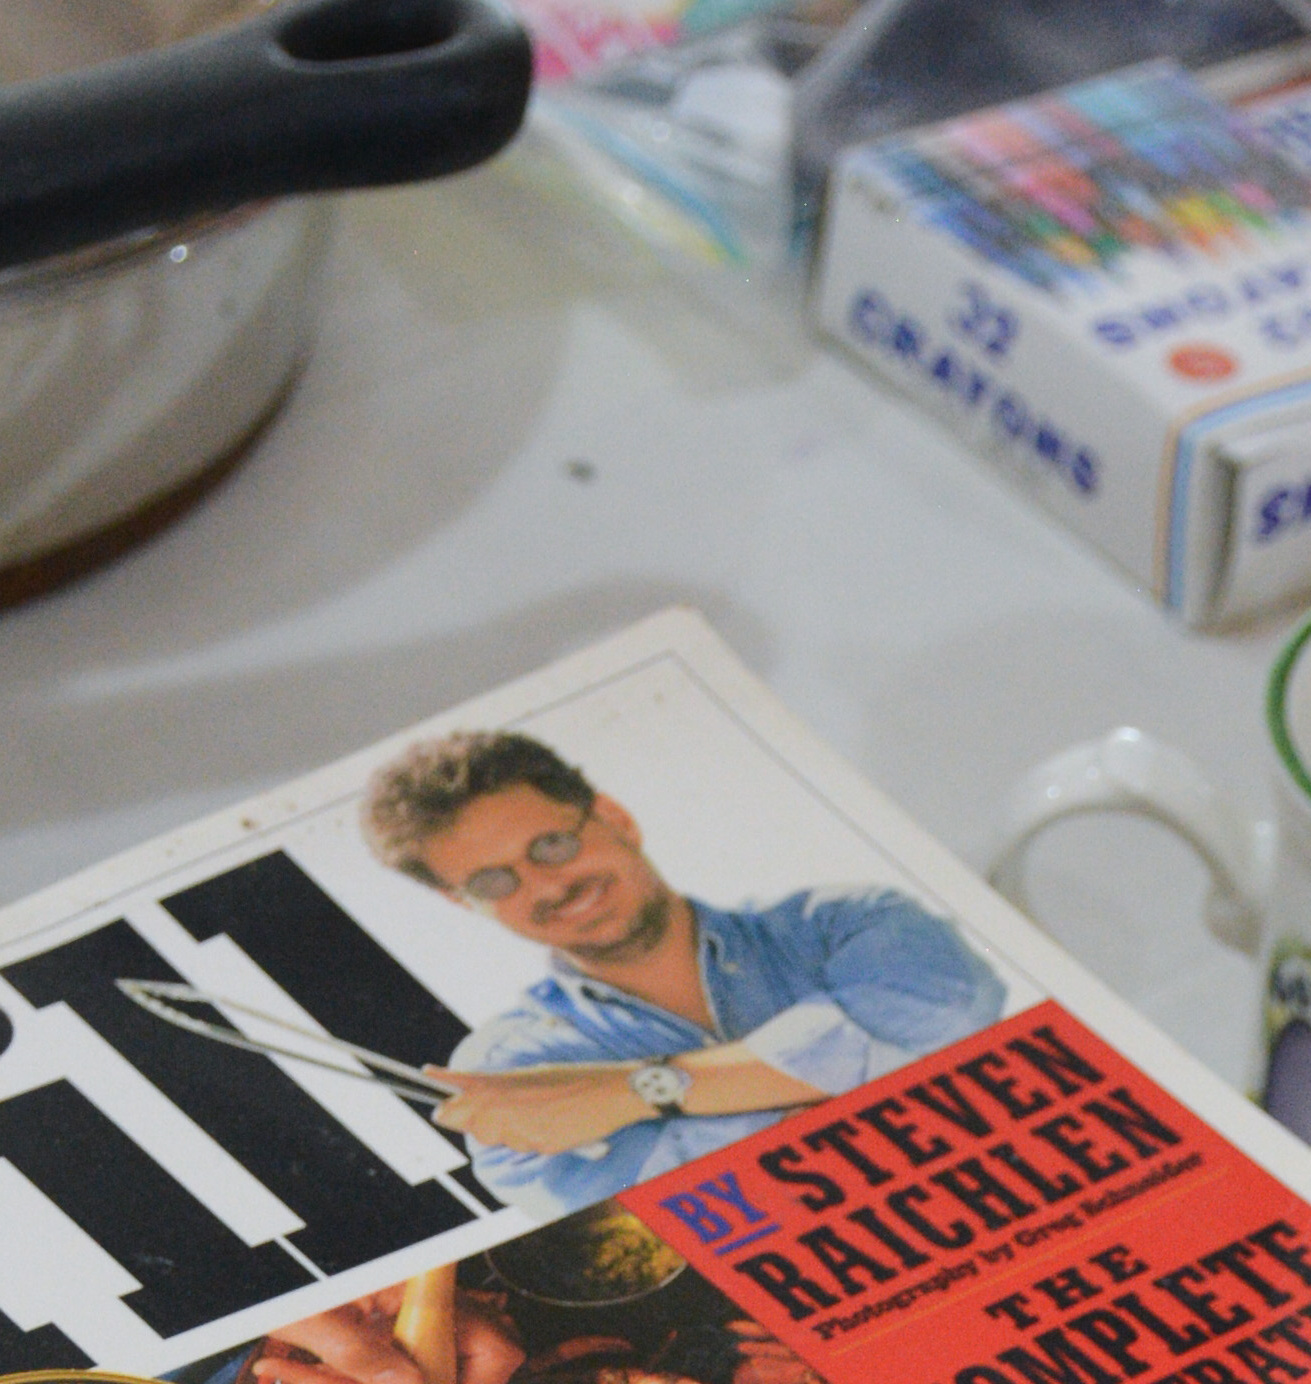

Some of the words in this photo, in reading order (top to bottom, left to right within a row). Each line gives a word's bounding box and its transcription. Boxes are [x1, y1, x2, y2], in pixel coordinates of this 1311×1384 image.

[846, 287, 1102, 496] CRAYONS
[658, 1170, 768, 1245] BY
[757, 1024, 1105, 1214] STEVEN
[732, 1087, 1184, 1322] RAICHLEN
[811, 1258, 980, 1341] Photography
[978, 1241, 1016, 1265] by
[1012, 1211, 1085, 1248] Greg
[983, 1242, 1150, 1332] THE
